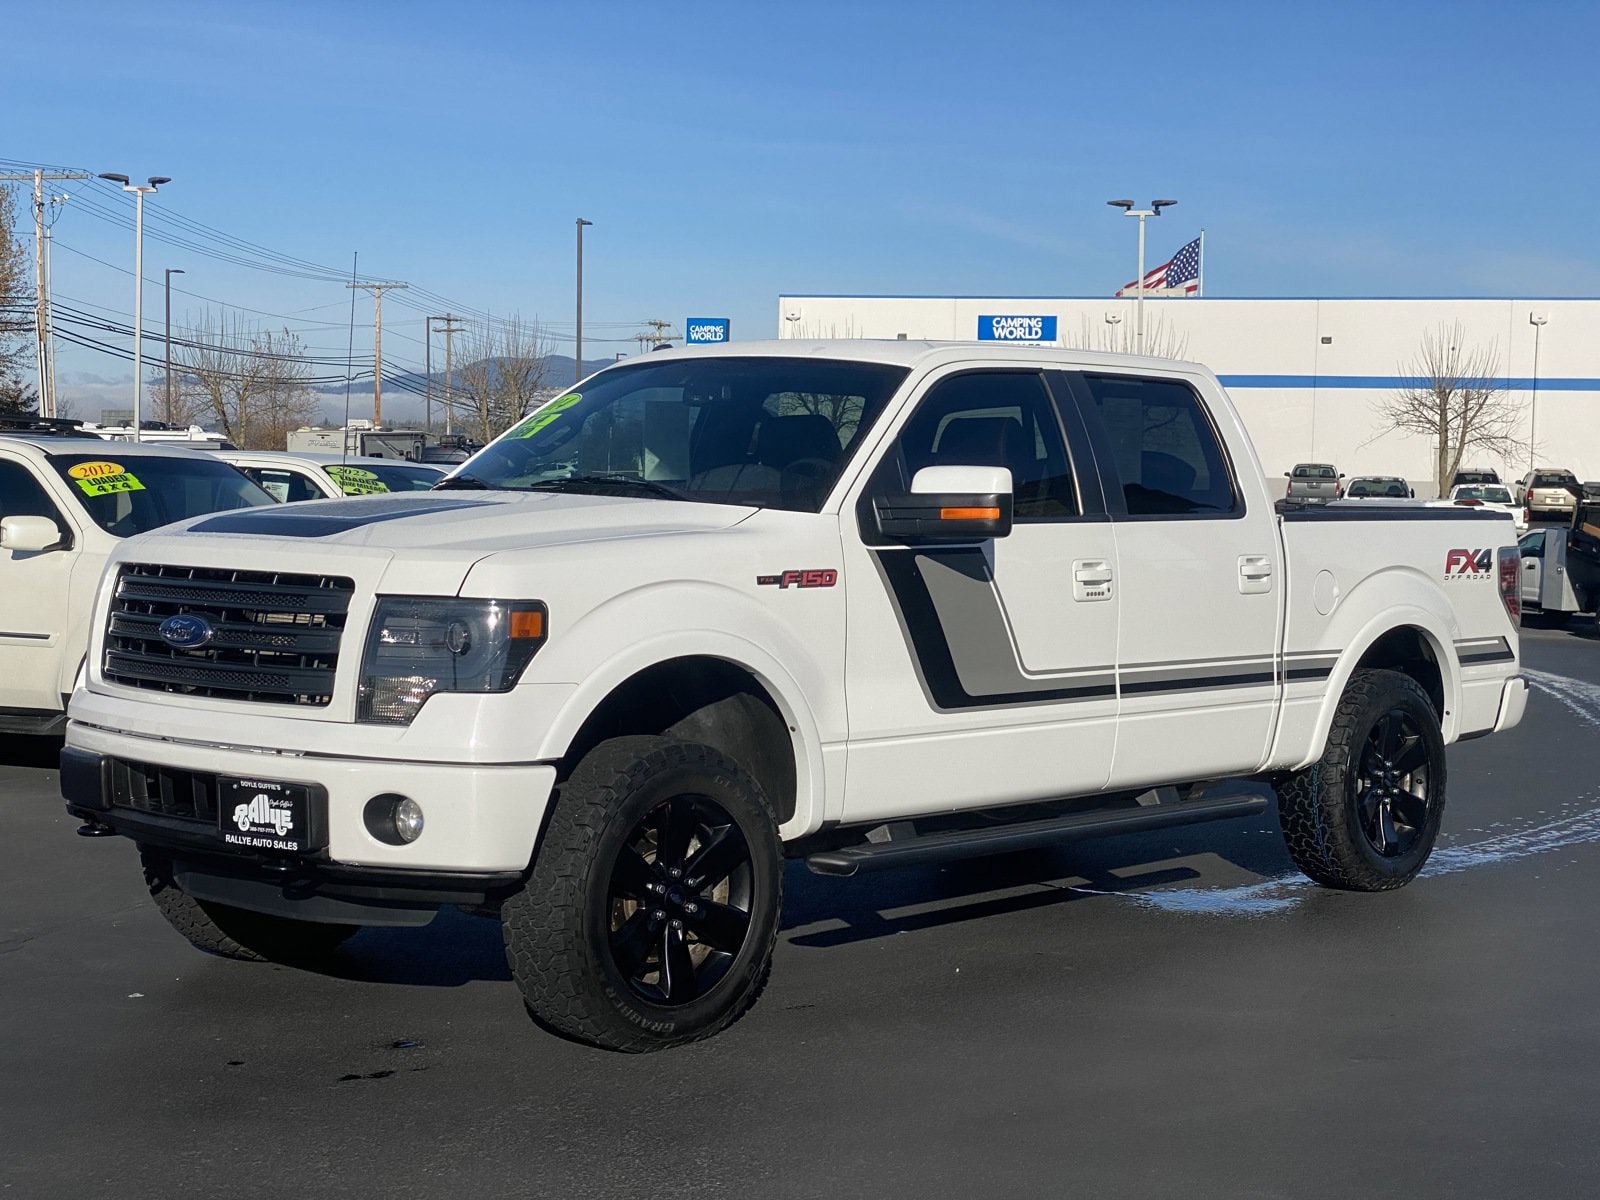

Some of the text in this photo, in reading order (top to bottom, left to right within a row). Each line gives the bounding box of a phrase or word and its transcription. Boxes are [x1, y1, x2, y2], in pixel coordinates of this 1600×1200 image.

[992, 317, 1042, 327] CAMPING
[690, 325, 724, 333] CAMPING
[992, 327, 1042, 339] WORLD
[690, 332, 724, 341] WORLD
[80, 464, 114, 477] 2012
[336, 467, 368, 478] 2022
[87, 474, 128, 486] LOADED
[1445, 549, 1492, 574] FX4
[781, 569, 838, 588] F-150
[225, 834, 298, 851] RALLYE AUTO SALES
